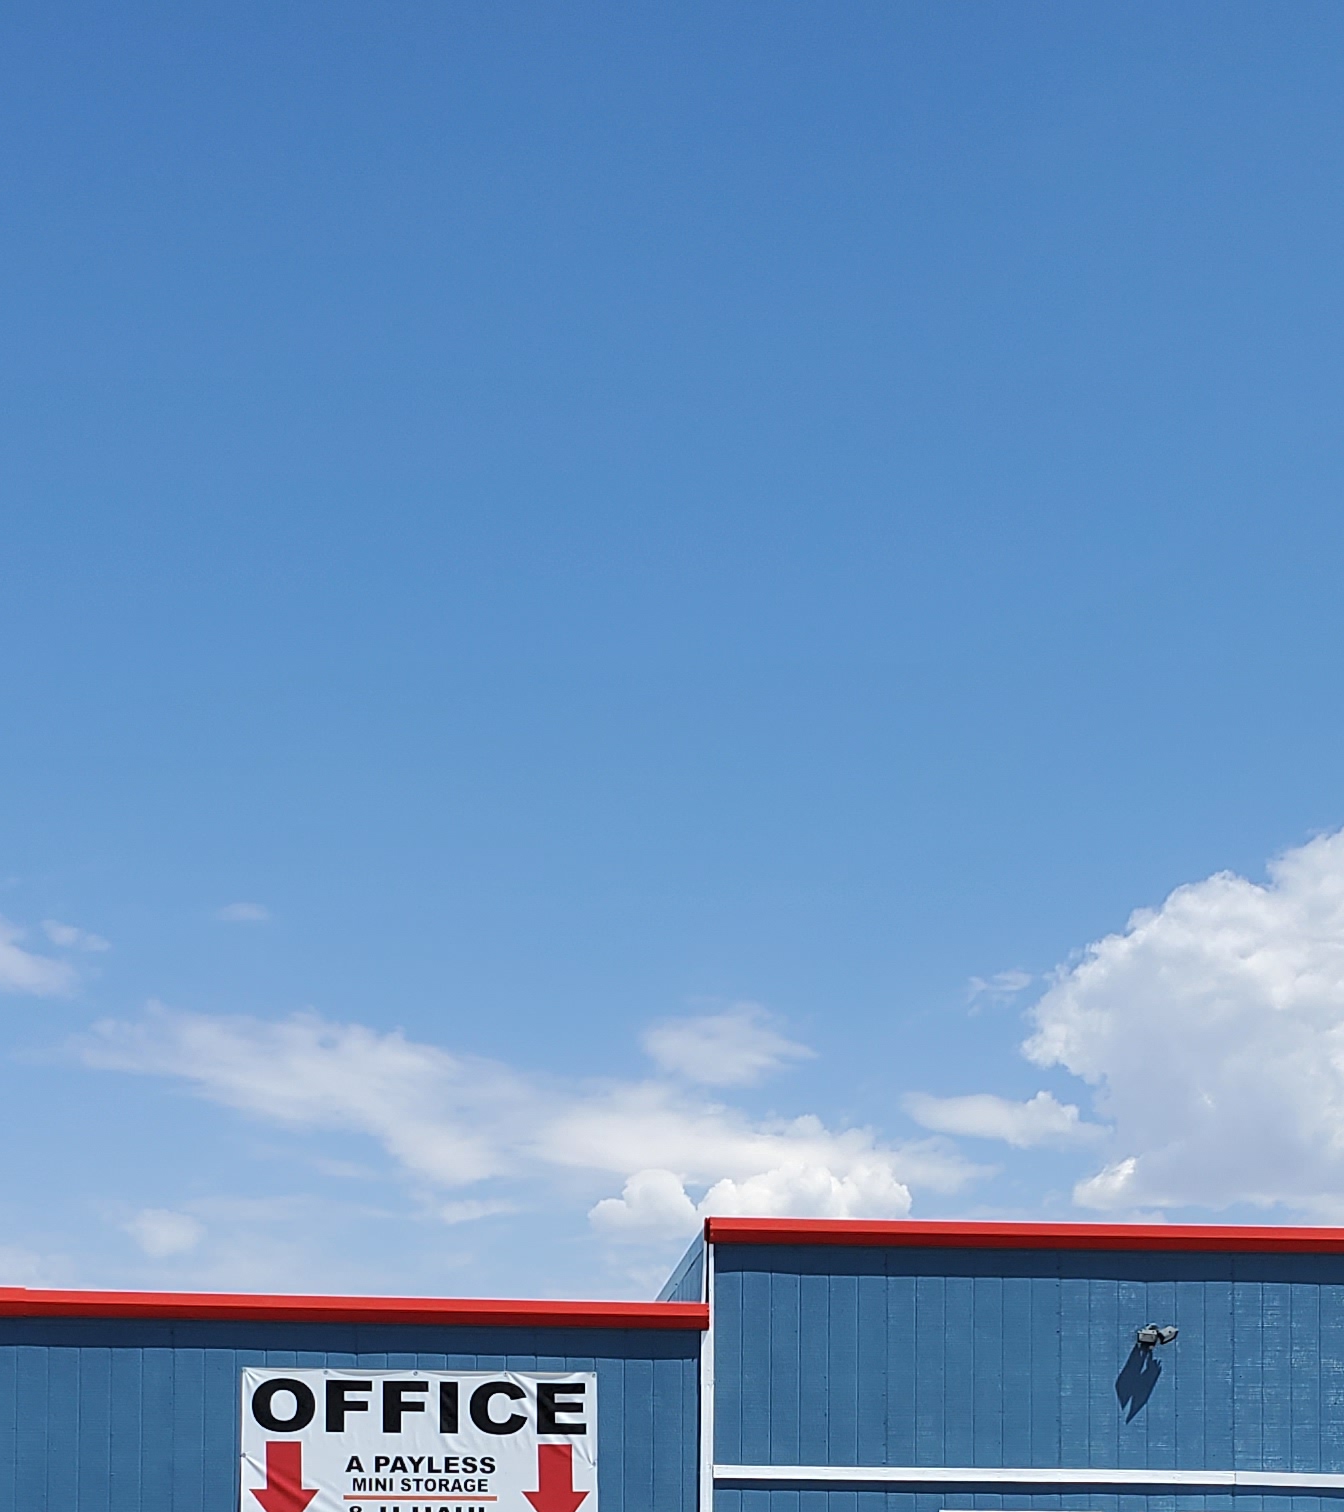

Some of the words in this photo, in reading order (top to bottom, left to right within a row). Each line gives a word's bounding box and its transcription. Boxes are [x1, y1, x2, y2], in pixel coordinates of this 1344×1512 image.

[251, 1378, 587, 1436] OFFICE
[345, 1456, 364, 1473] A
[374, 1456, 496, 1475] PAYLESS
[352, 1477, 395, 1492] MINI
[400, 1478, 489, 1493] STORAGE
